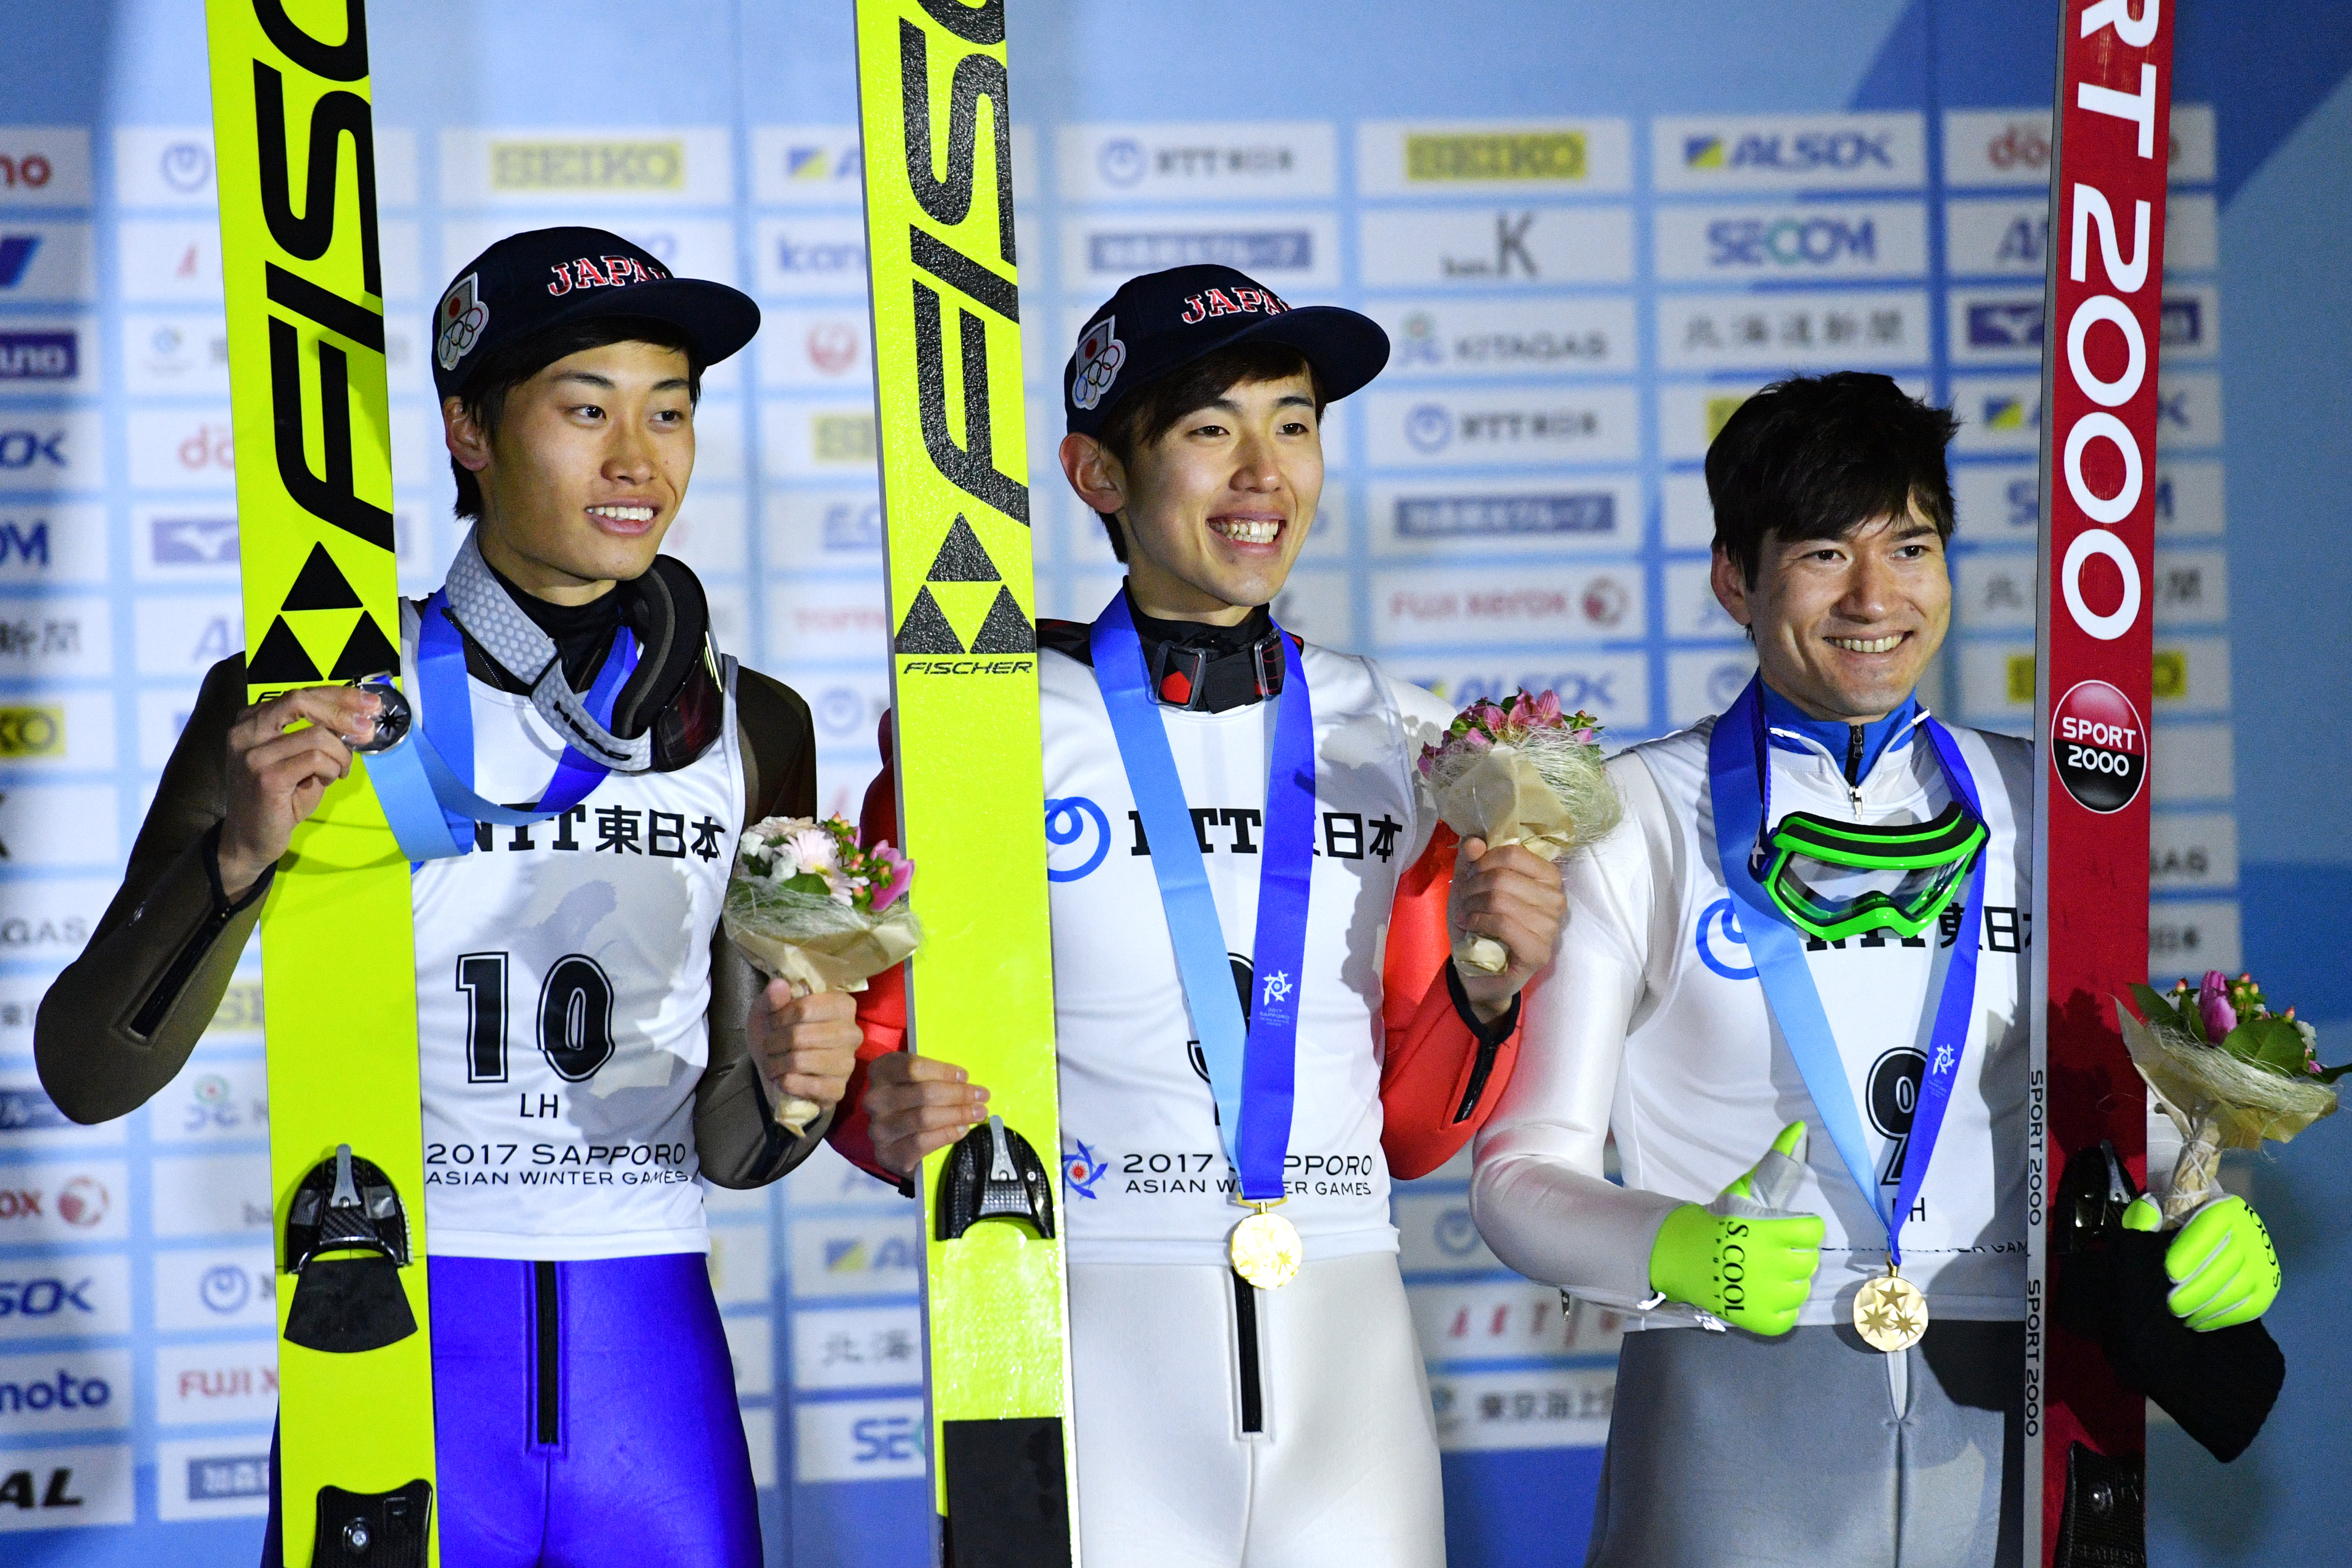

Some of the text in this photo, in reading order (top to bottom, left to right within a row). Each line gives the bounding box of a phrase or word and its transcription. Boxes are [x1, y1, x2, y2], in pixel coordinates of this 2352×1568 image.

[1706, 217, 1876, 266] SECOM
[2061, 182, 2152, 640] 2000
[903, 661, 1033, 675] FISCHER
[2061, 716, 2137, 750] SPORT
[2067, 744, 2130, 777] 2000
[456, 951, 615, 1083] 10
[520, 1093, 558, 1118] LH
[427, 1143, 686, 1165] 2017 SAPPORO
[1123, 1153, 1213, 1173] 2017
[2029, 1070, 2043, 1227] SPORT 2000
[426, 1171, 689, 1185] ASIAN WINTER GAMES
[1126, 1179, 1206, 1193] ASIAN
[1315, 1181, 1371, 1195] GAMES
[2025, 1280, 2041, 1437] SPORT 2000
